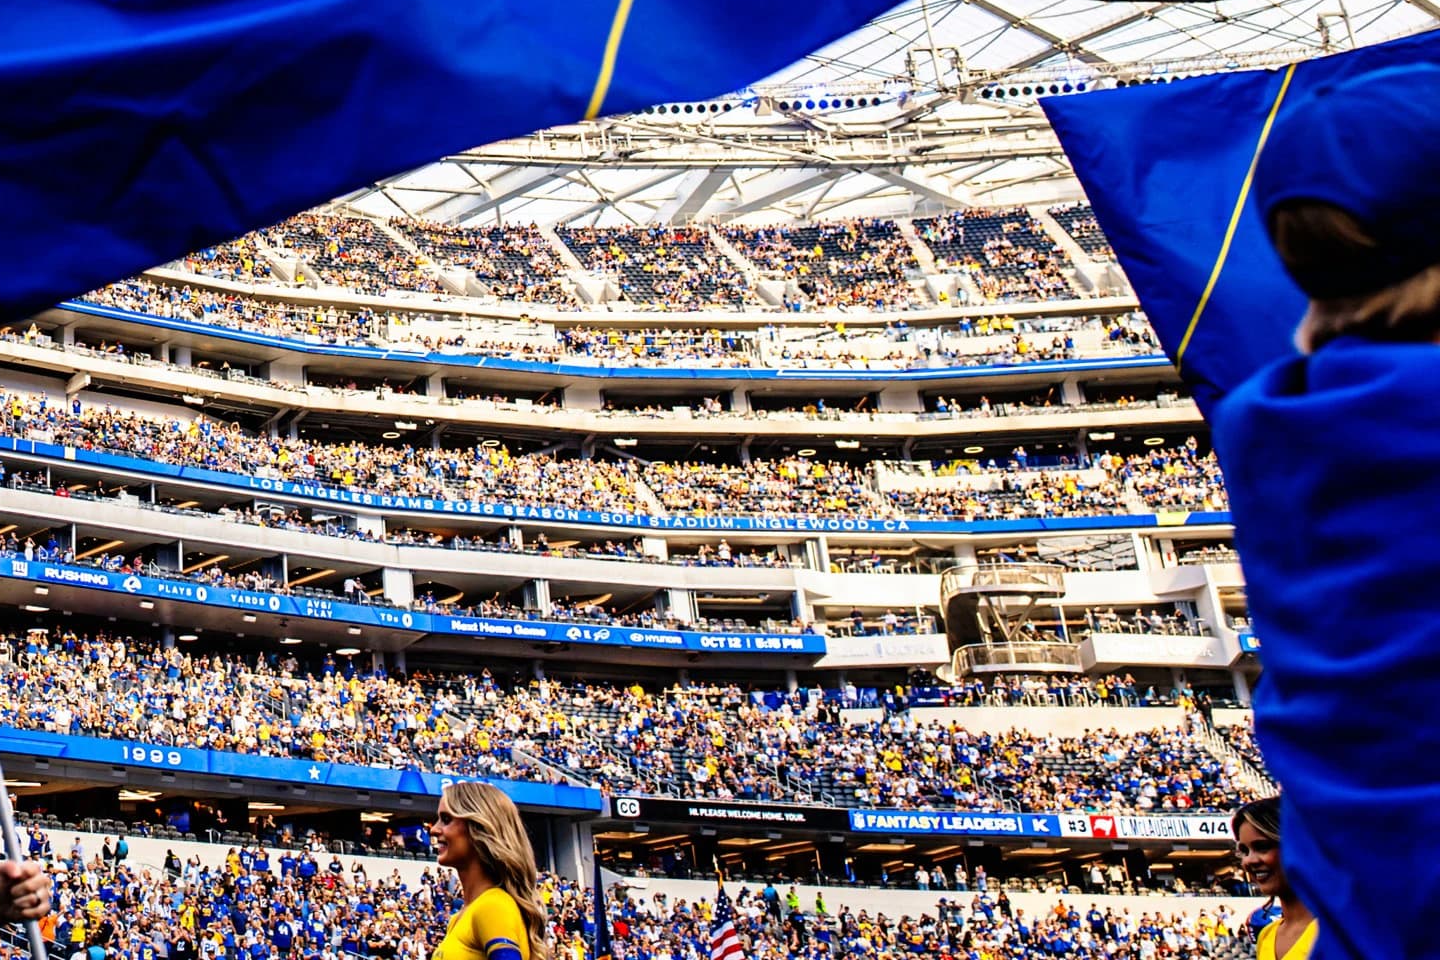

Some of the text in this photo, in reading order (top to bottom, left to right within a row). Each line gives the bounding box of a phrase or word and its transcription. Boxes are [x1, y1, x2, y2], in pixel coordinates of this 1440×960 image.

[250, 478, 284, 491] LOS
[293, 484, 373, 505] ANGELES
[382, 496, 434, 510] RAMS
[503, 505, 579, 521] SEASON
[600, 514, 642, 526] SOFI
[884, 520, 910, 530] CA
[45, 567, 109, 585] RUSHING
[158, 584, 208, 602] PLAYS 0
[231, 594, 281, 611] YARDS 0
[307, 608, 333, 619] PLAY
[402, 613, 413, 628] 0
[451, 620, 547, 637] Next Home Game
[700, 636, 726, 649] OCT
[782, 639, 804, 650] PM
[122, 745, 182, 766] 1999
[620, 800, 638, 815] CC
[699, 808, 727, 818] PLEASE
[727, 809, 762, 820] WELCOME
[867, 814, 1050, 833] FANTASY LEADERS K
[1068, 820, 1087, 833] #3
[1199, 822, 1229, 835] 4/4
